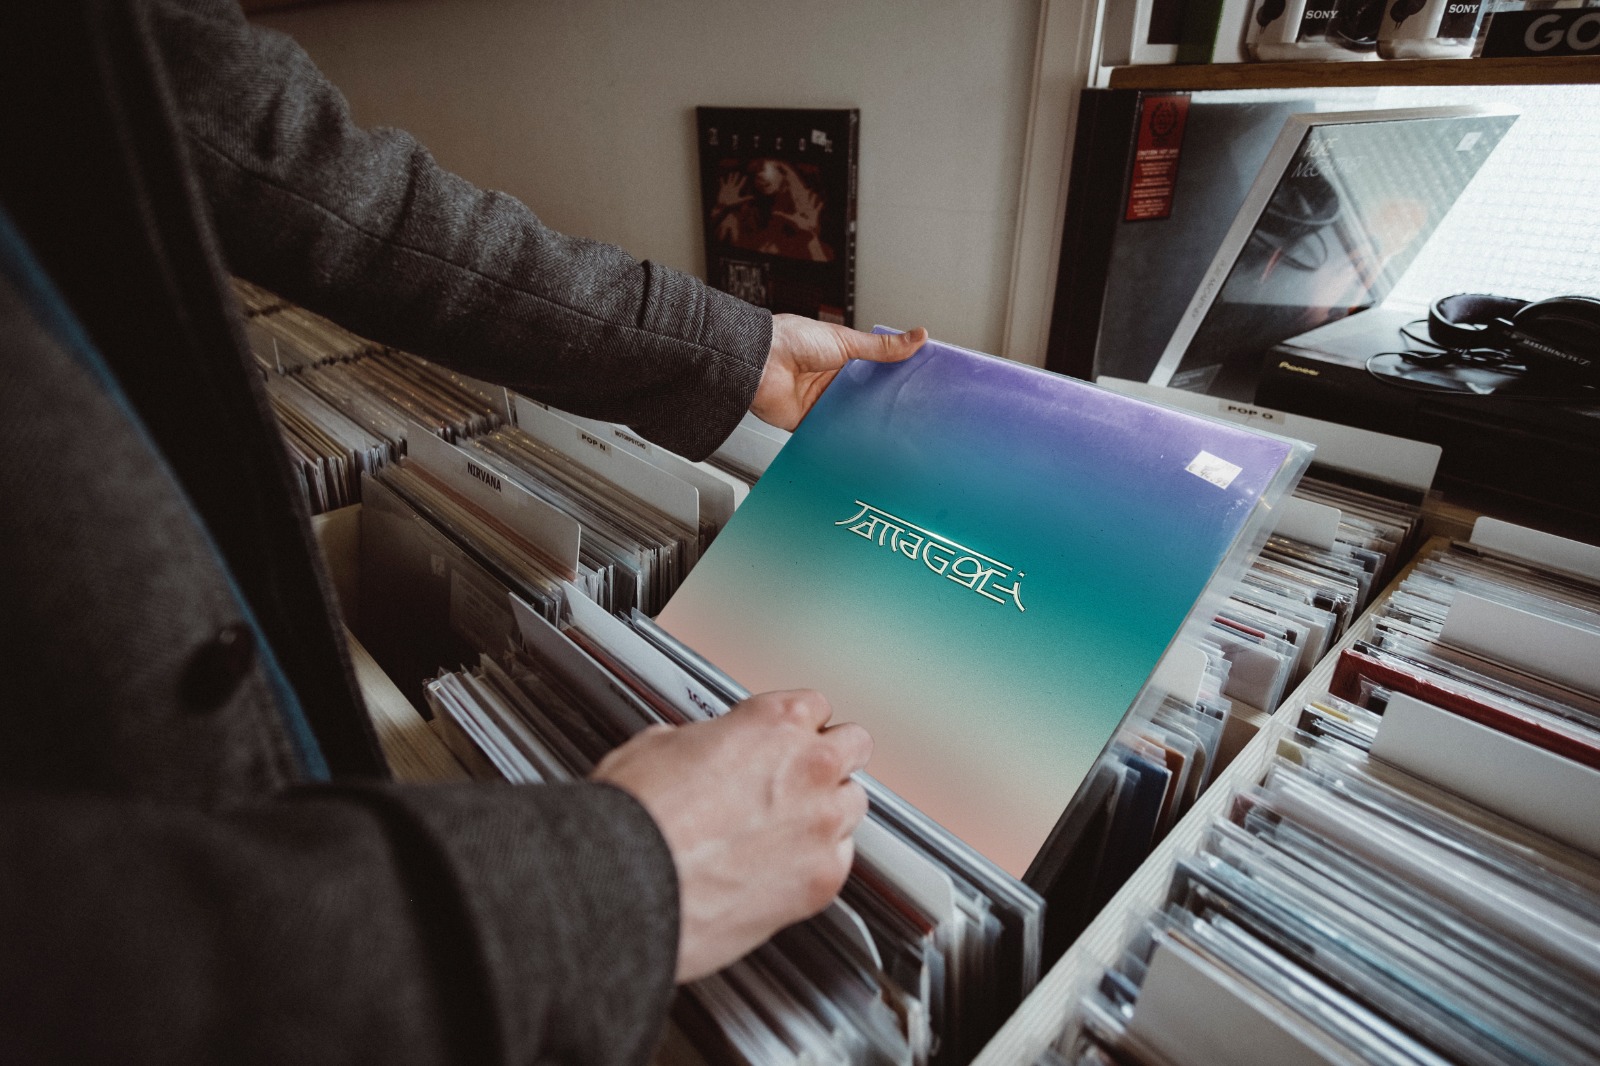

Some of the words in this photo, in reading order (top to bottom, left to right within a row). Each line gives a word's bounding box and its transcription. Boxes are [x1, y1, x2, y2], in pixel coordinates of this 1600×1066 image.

[1305, 10, 1339, 19] SONY
[1448, 4, 1479, 14] SONY
[1279, 361, 1320, 376] Pioneer
[1228, 405, 1257, 415] POP
[581, 433, 598, 446] POP
[600, 443, 606, 451] N
[467, 462, 502, 493] NIRVANA
